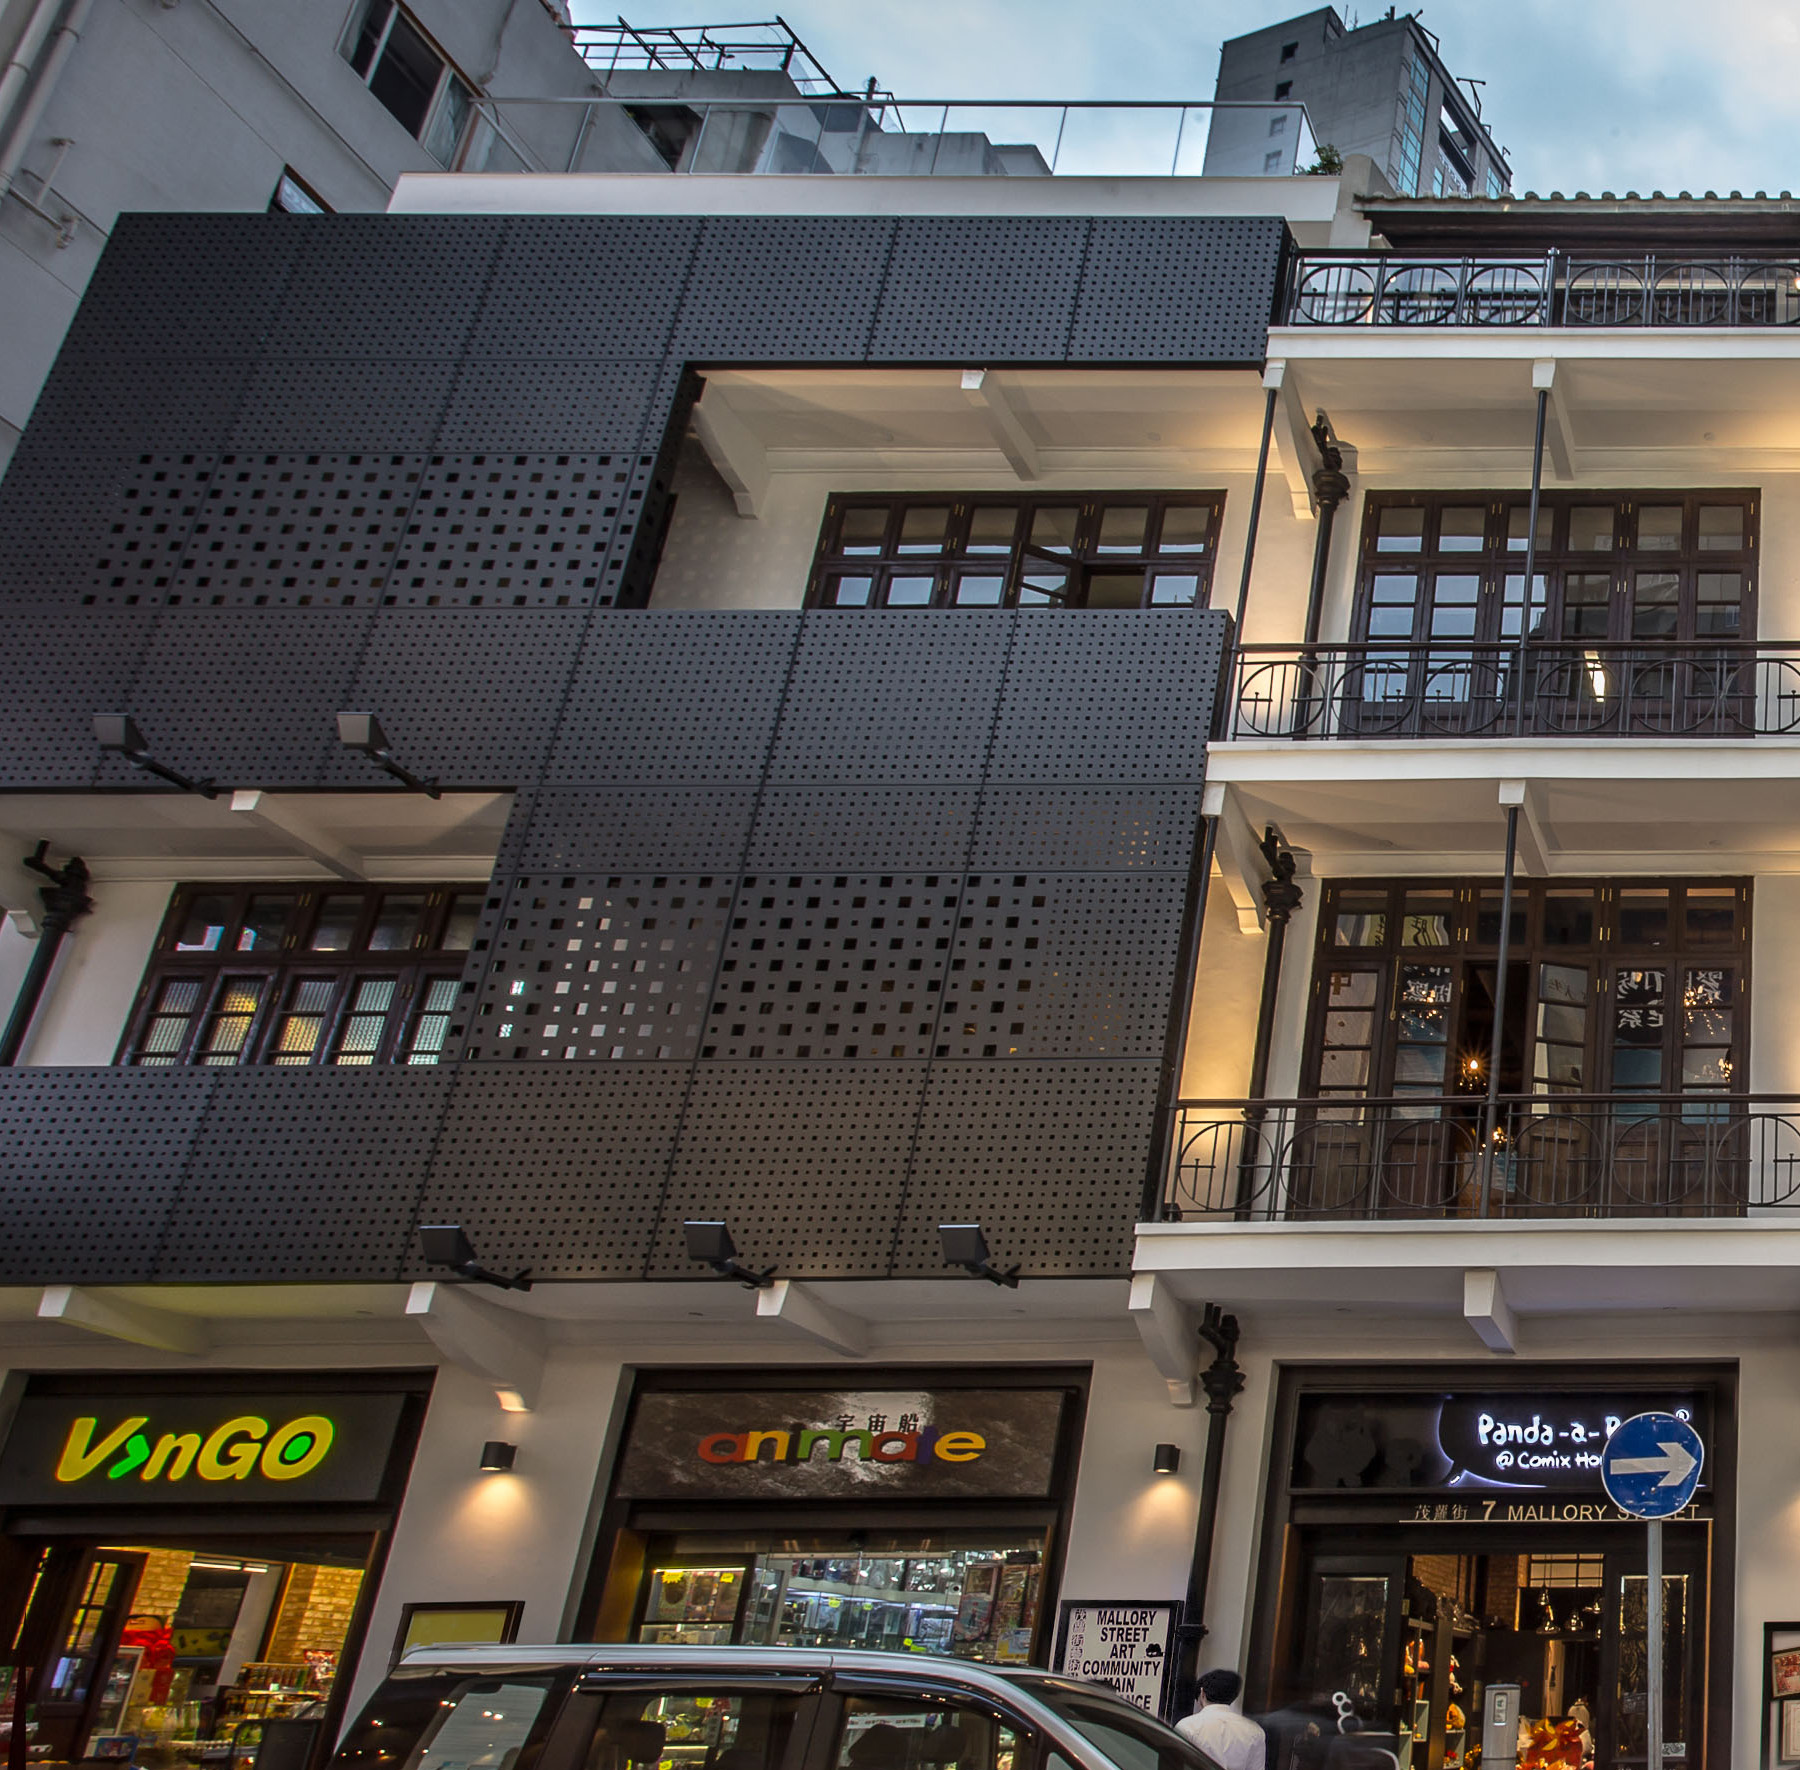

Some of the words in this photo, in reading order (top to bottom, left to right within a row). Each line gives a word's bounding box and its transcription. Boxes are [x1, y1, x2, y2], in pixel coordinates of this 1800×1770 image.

[836, 1413, 920, 1433] 宇宙船
[698, 1421, 986, 1465] animate
[1516, 1450, 1571, 1469] Comix
[1415, 1503, 1468, 1521] 茂蘿街
[1482, 1500, 1497, 1521] 7
[1508, 1504, 1608, 1521] MALLORY
[1096, 1610, 1158, 1626] MALLORY
[1100, 1626, 1150, 1643] STREET
[1109, 1643, 1136, 1660] ART
[1082, 1660, 1161, 1677] COMMUNITY
